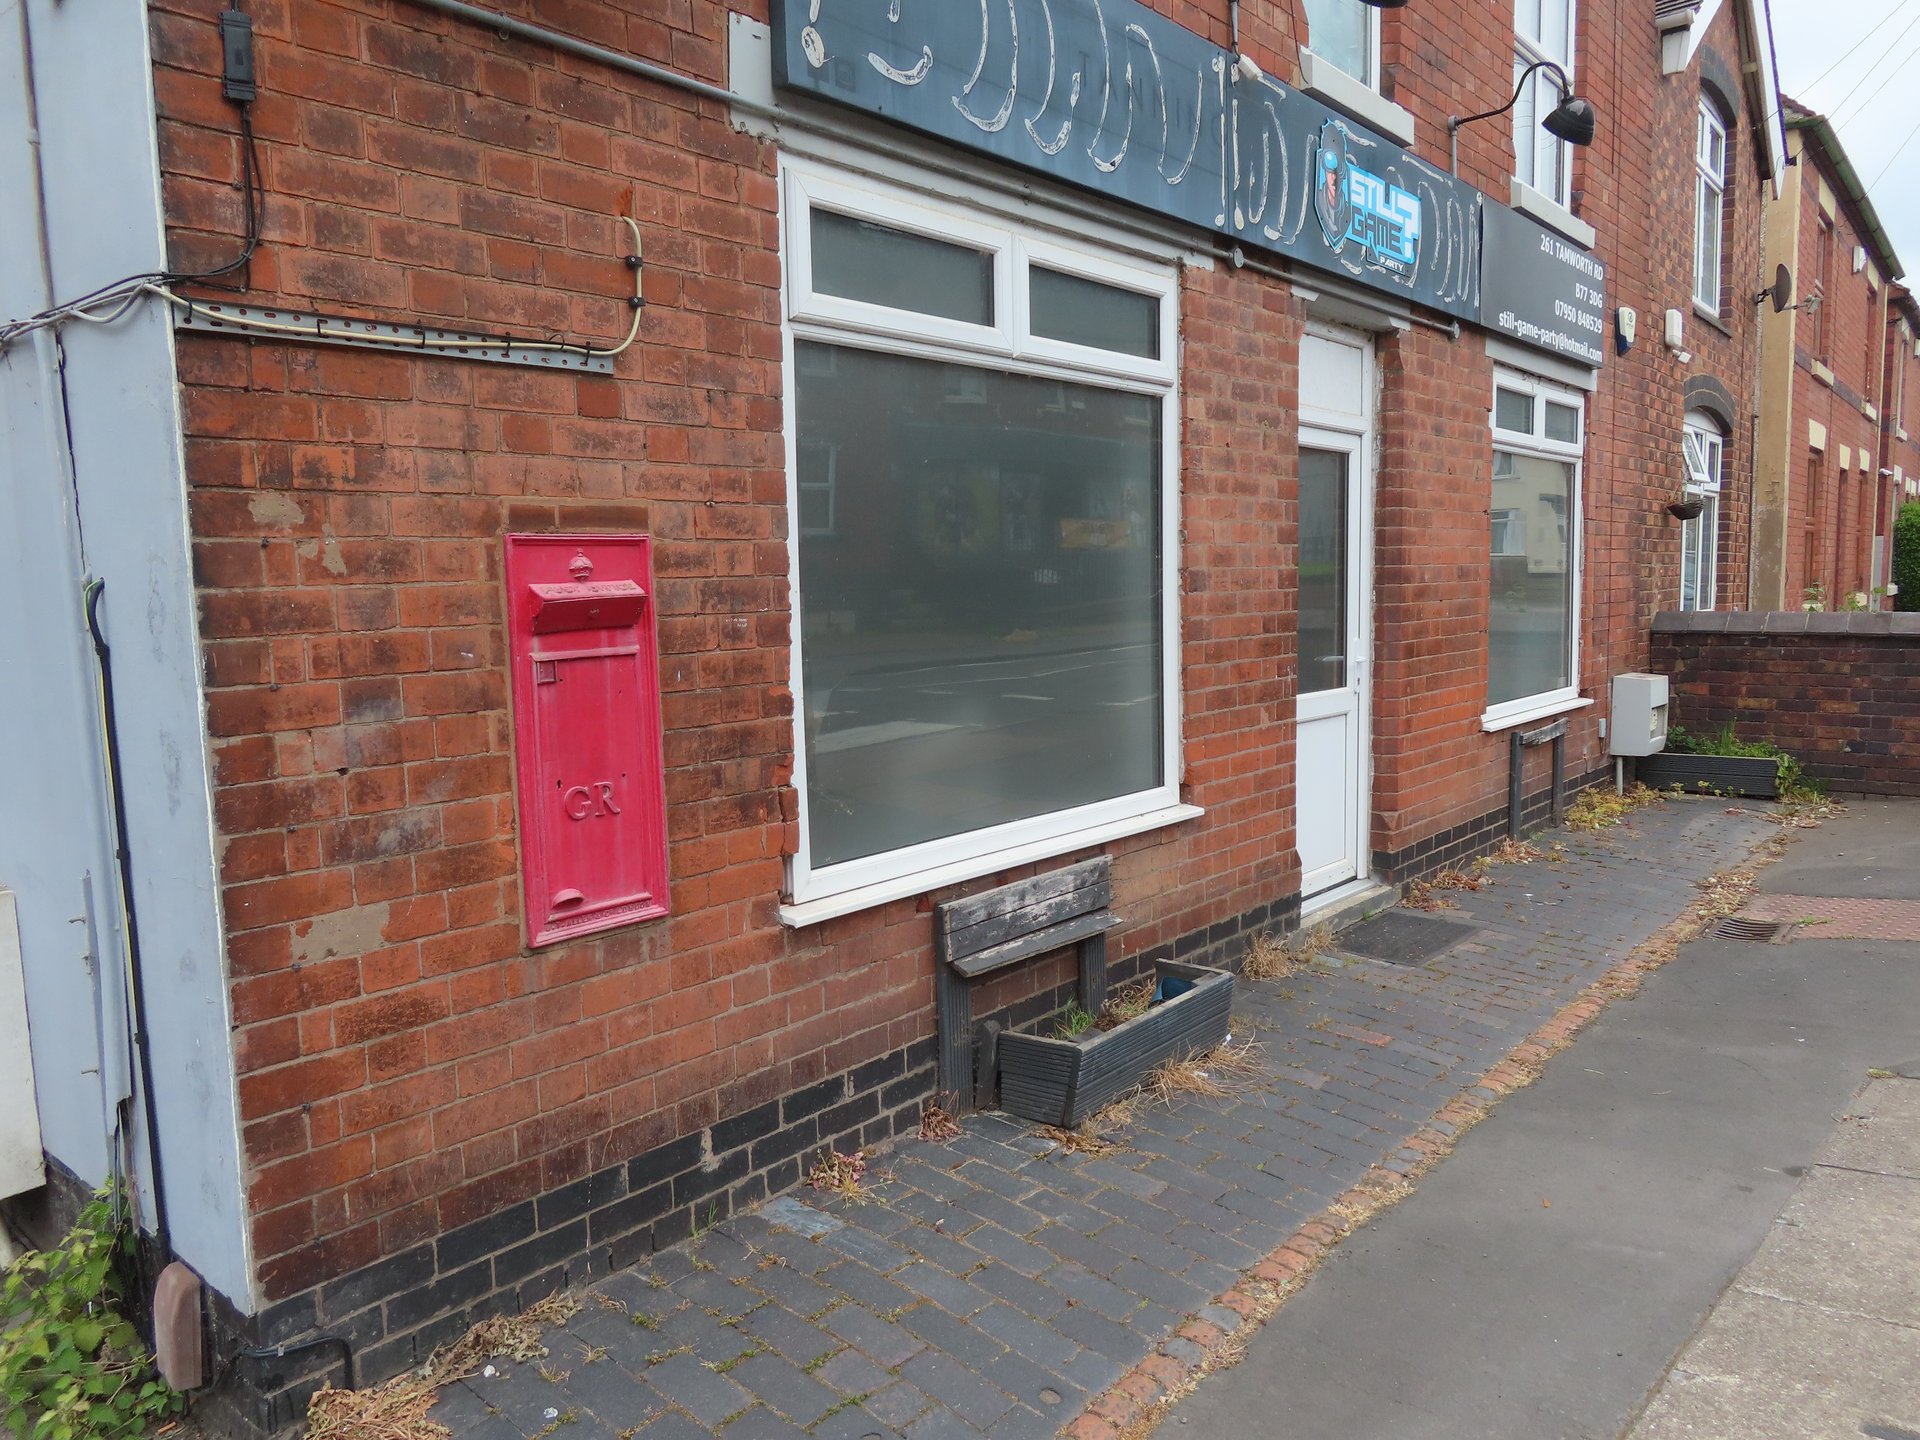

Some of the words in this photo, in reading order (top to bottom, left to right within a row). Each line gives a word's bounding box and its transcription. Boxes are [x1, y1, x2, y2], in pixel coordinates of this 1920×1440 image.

[1352, 206, 1403, 253] GAME
[1380, 256, 1405, 271] PARTY
[1540, 234, 1554, 255] 261
[1555, 243, 1594, 277] TAMWORTH
[1594, 263, 1604, 281] RD
[1575, 283, 1588, 302] B77
[1589, 289, 1603, 308] 3DG
[1554, 299, 1577, 323] 07950
[1577, 313, 1603, 334] 848529
[1499, 311, 1603, 363] still-game-party@hotmail.com
[564, 780, 621, 820] GR
